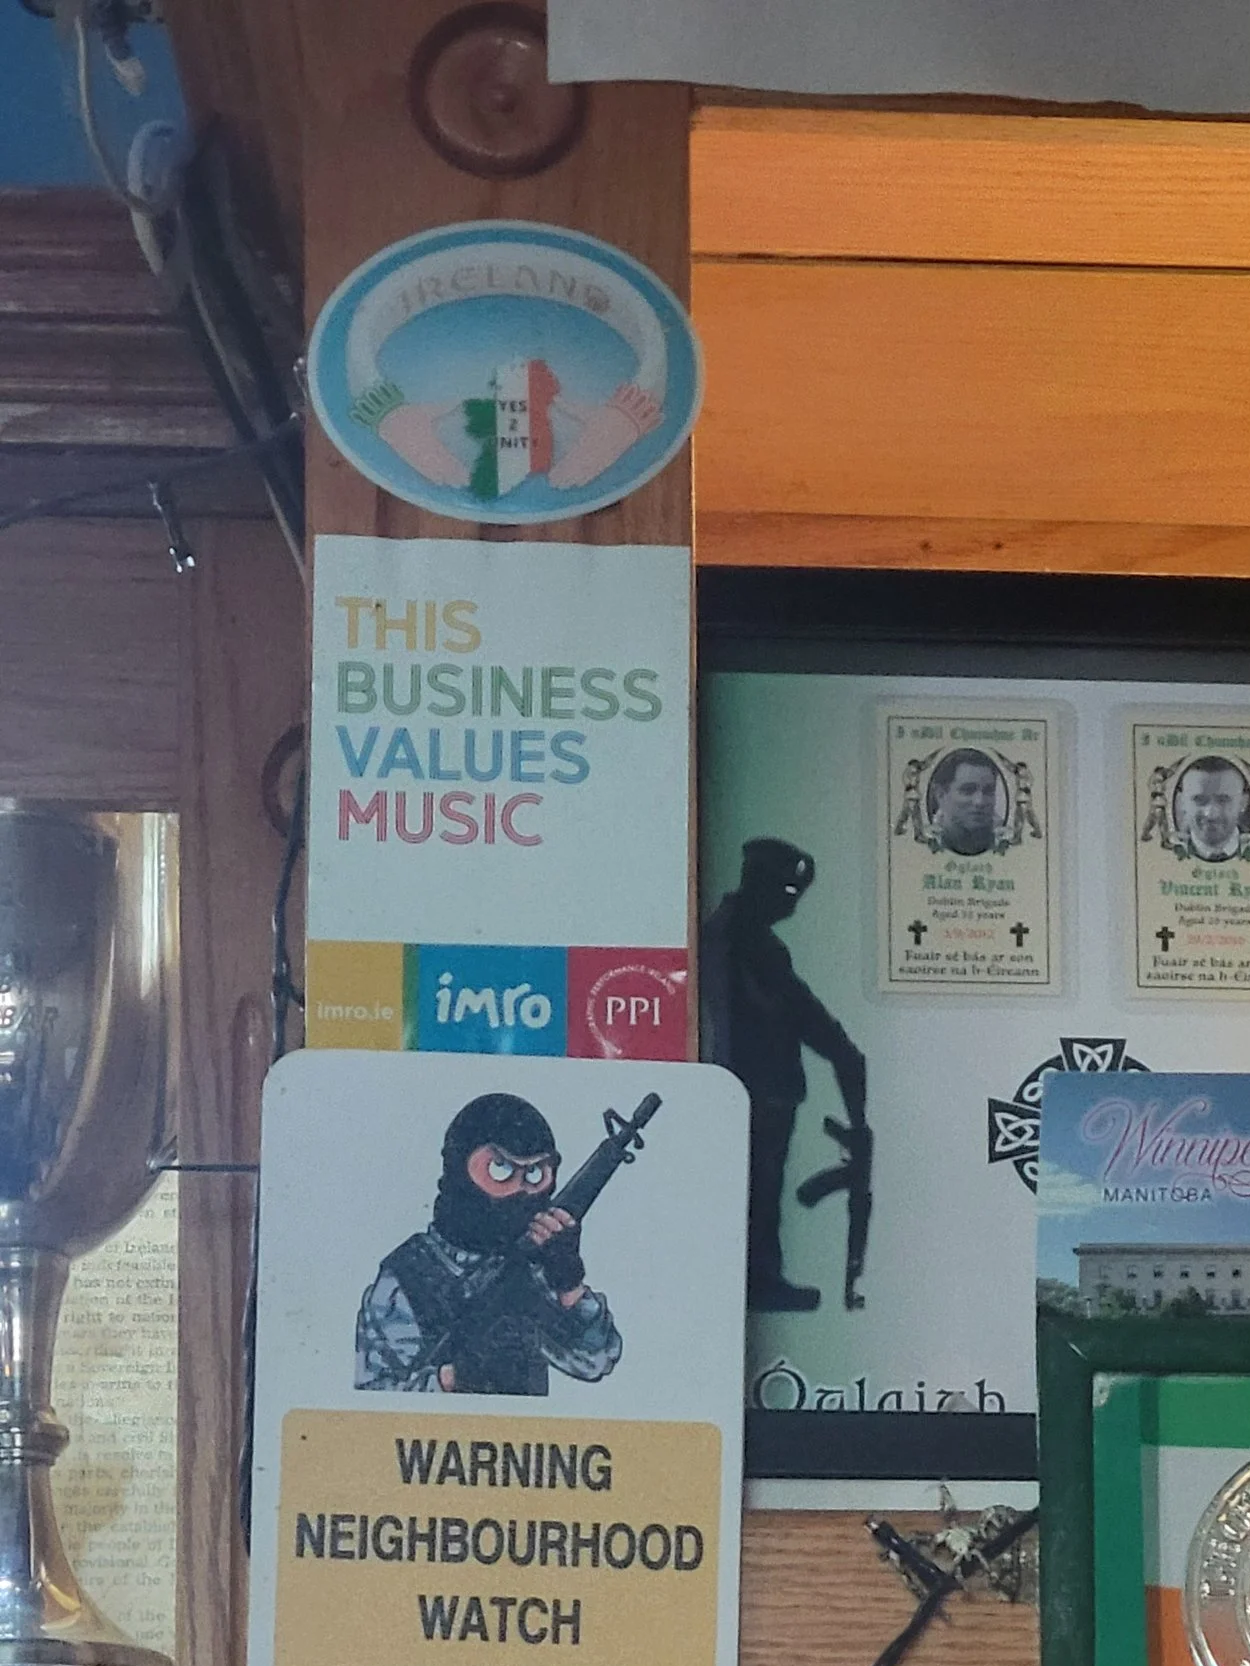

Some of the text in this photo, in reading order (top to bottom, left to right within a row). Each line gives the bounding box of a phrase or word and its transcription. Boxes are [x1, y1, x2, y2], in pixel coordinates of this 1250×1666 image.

[500, 400, 528, 412] YES
[508, 420, 518, 431] 2
[335, 596, 481, 653] THIS
[337, 661, 662, 722] BUSINESS
[335, 725, 590, 784] VALUES
[338, 789, 544, 847] MUSIC
[317, 1002, 394, 1022] imro.ie
[436, 971, 552, 1028] imro
[605, 996, 662, 1027] PPI
[1103, 1187, 1213, 1203] MANITOBA
[395, 1438, 612, 1492] WARNING
[295, 1512, 705, 1571] NEIGHBOURHOOD
[418, 1595, 581, 1645] WATCH
